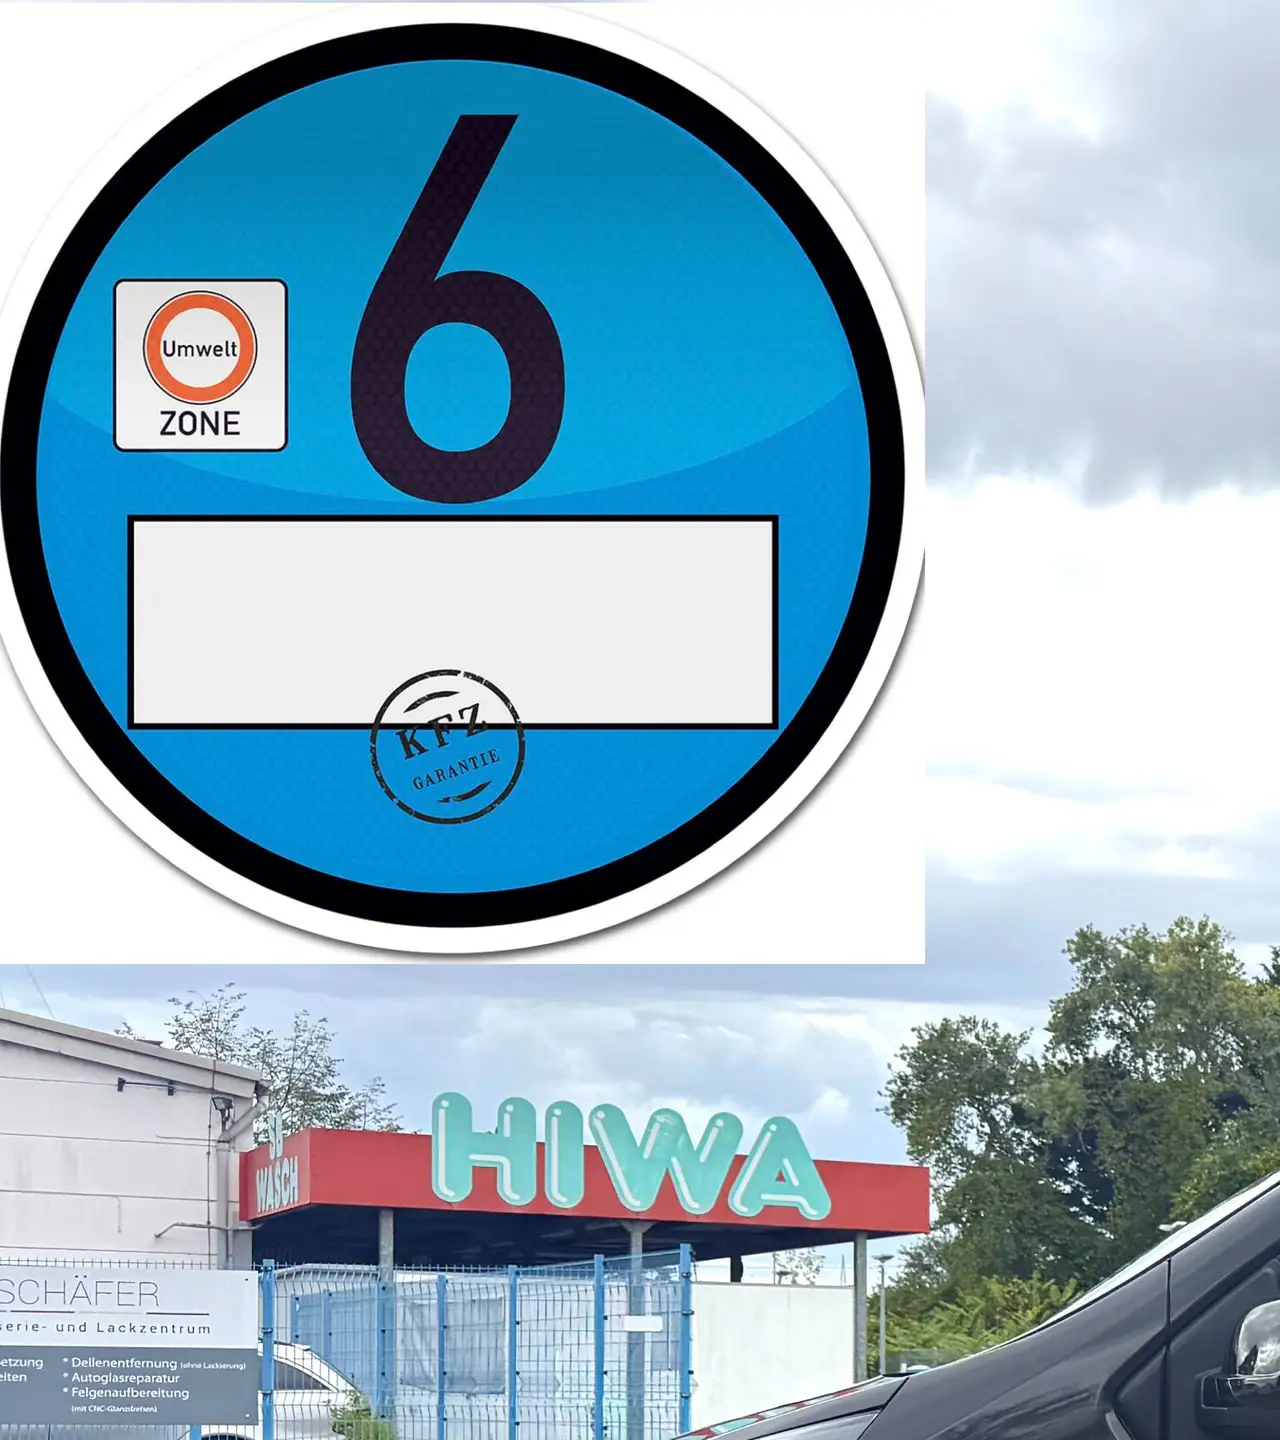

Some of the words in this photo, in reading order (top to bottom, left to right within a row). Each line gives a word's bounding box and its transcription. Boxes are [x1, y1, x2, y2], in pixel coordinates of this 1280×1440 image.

[431, 1092, 831, 1221] HIWA
[256, 1155, 298, 1213] WASCH
[0, 1275, 160, 1306] SCHÄFER
[0, 1320, 47, 1333] erie-
[56, 1321, 87, 1333] und
[97, 1322, 212, 1335] Lackzentrum
[72, 1357, 177, 1371] Dellenentfernung
[72, 1372, 180, 1385] Autoglasreparatur
[72, 1386, 189, 1400] Felgenaufbereitung
[71, 1405, 87, 1413] (mit
